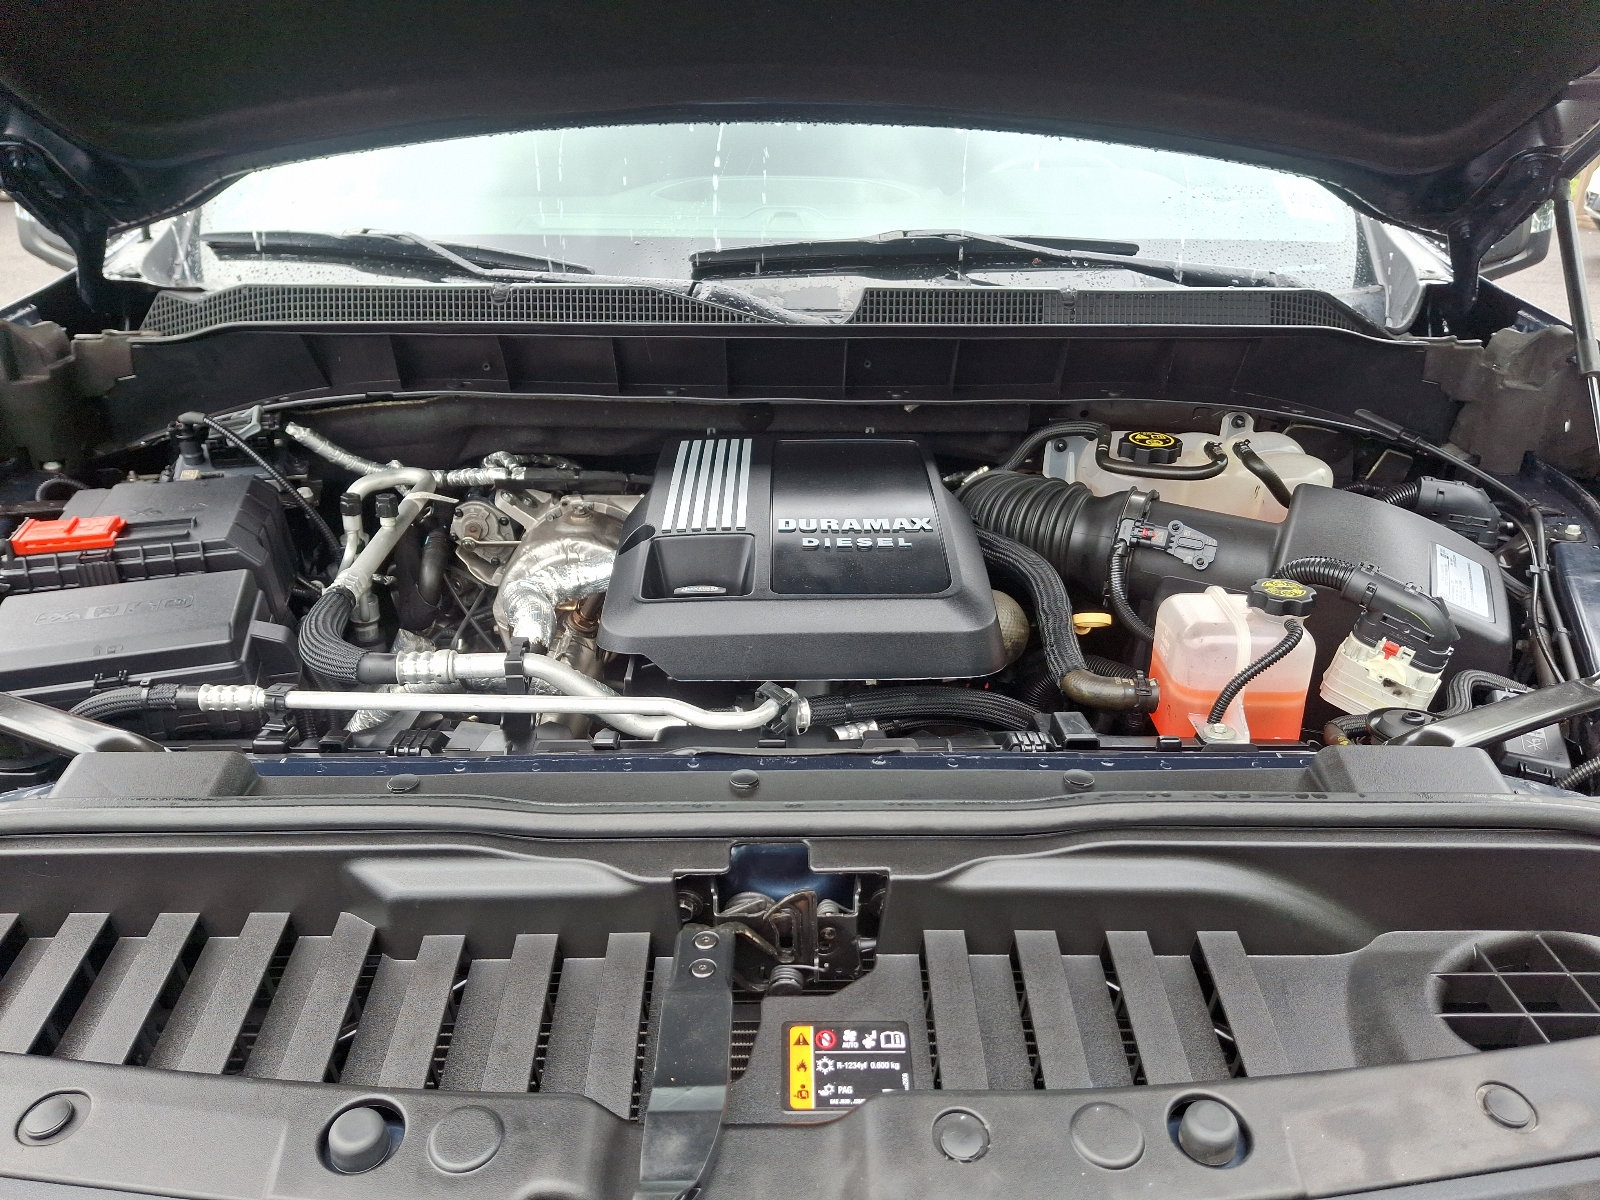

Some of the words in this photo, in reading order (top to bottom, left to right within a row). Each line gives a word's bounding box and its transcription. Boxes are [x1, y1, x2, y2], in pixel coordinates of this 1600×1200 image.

[778, 517, 934, 533] DURAMAX
[801, 537, 913, 551] DIESEL
[836, 1061, 868, 1070] R-1234yf
[890, 1061, 901, 1070] kg
[837, 1085, 854, 1094] PAG
